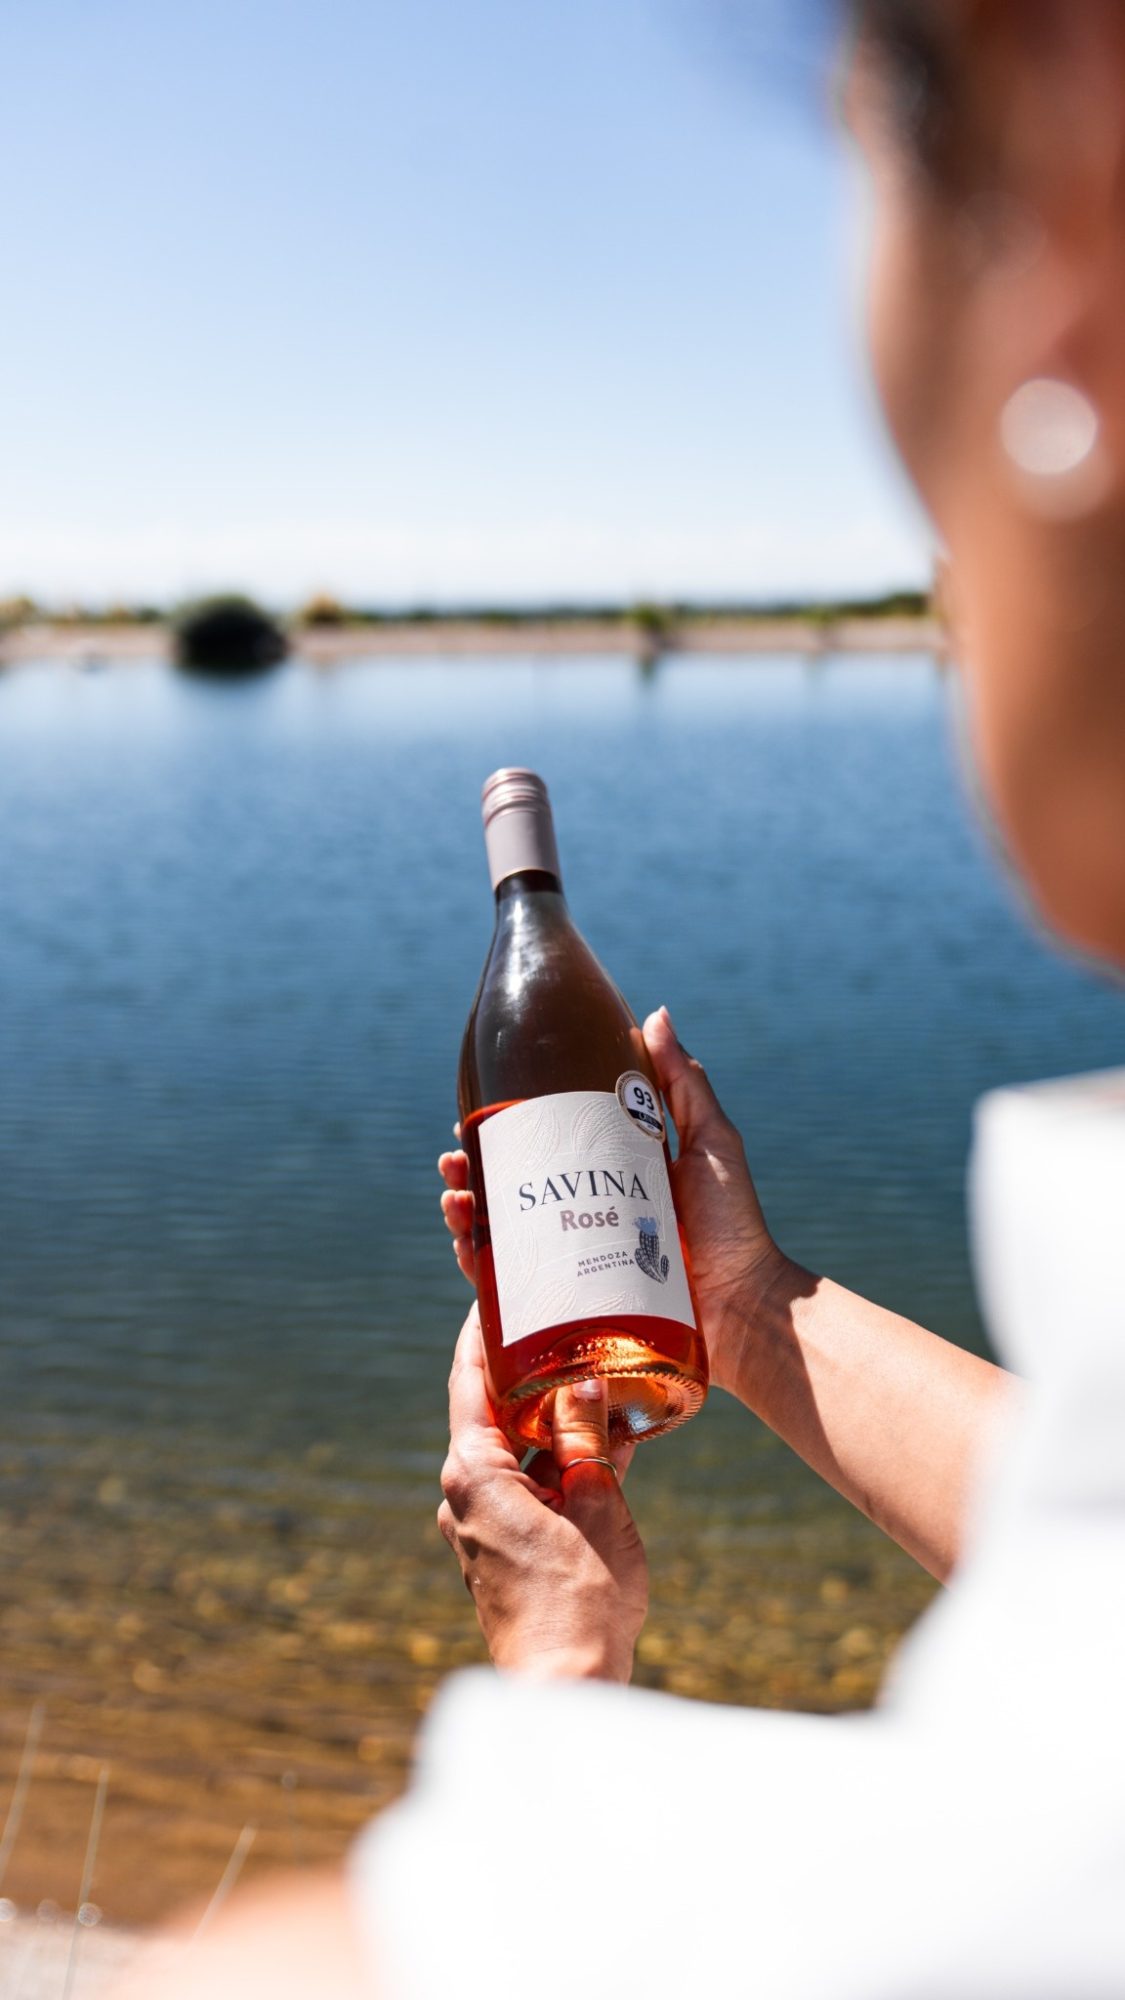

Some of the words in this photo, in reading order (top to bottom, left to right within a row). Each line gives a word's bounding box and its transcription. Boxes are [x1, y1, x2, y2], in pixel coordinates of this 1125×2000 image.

[633, 1087, 655, 1110] 93
[519, 1170, 651, 1211] SAVINA
[560, 1206, 619, 1231] Rosé
[577, 1259, 635, 1276] ARGENTINA
[578, 1251, 628, 1267] MENDOZA
